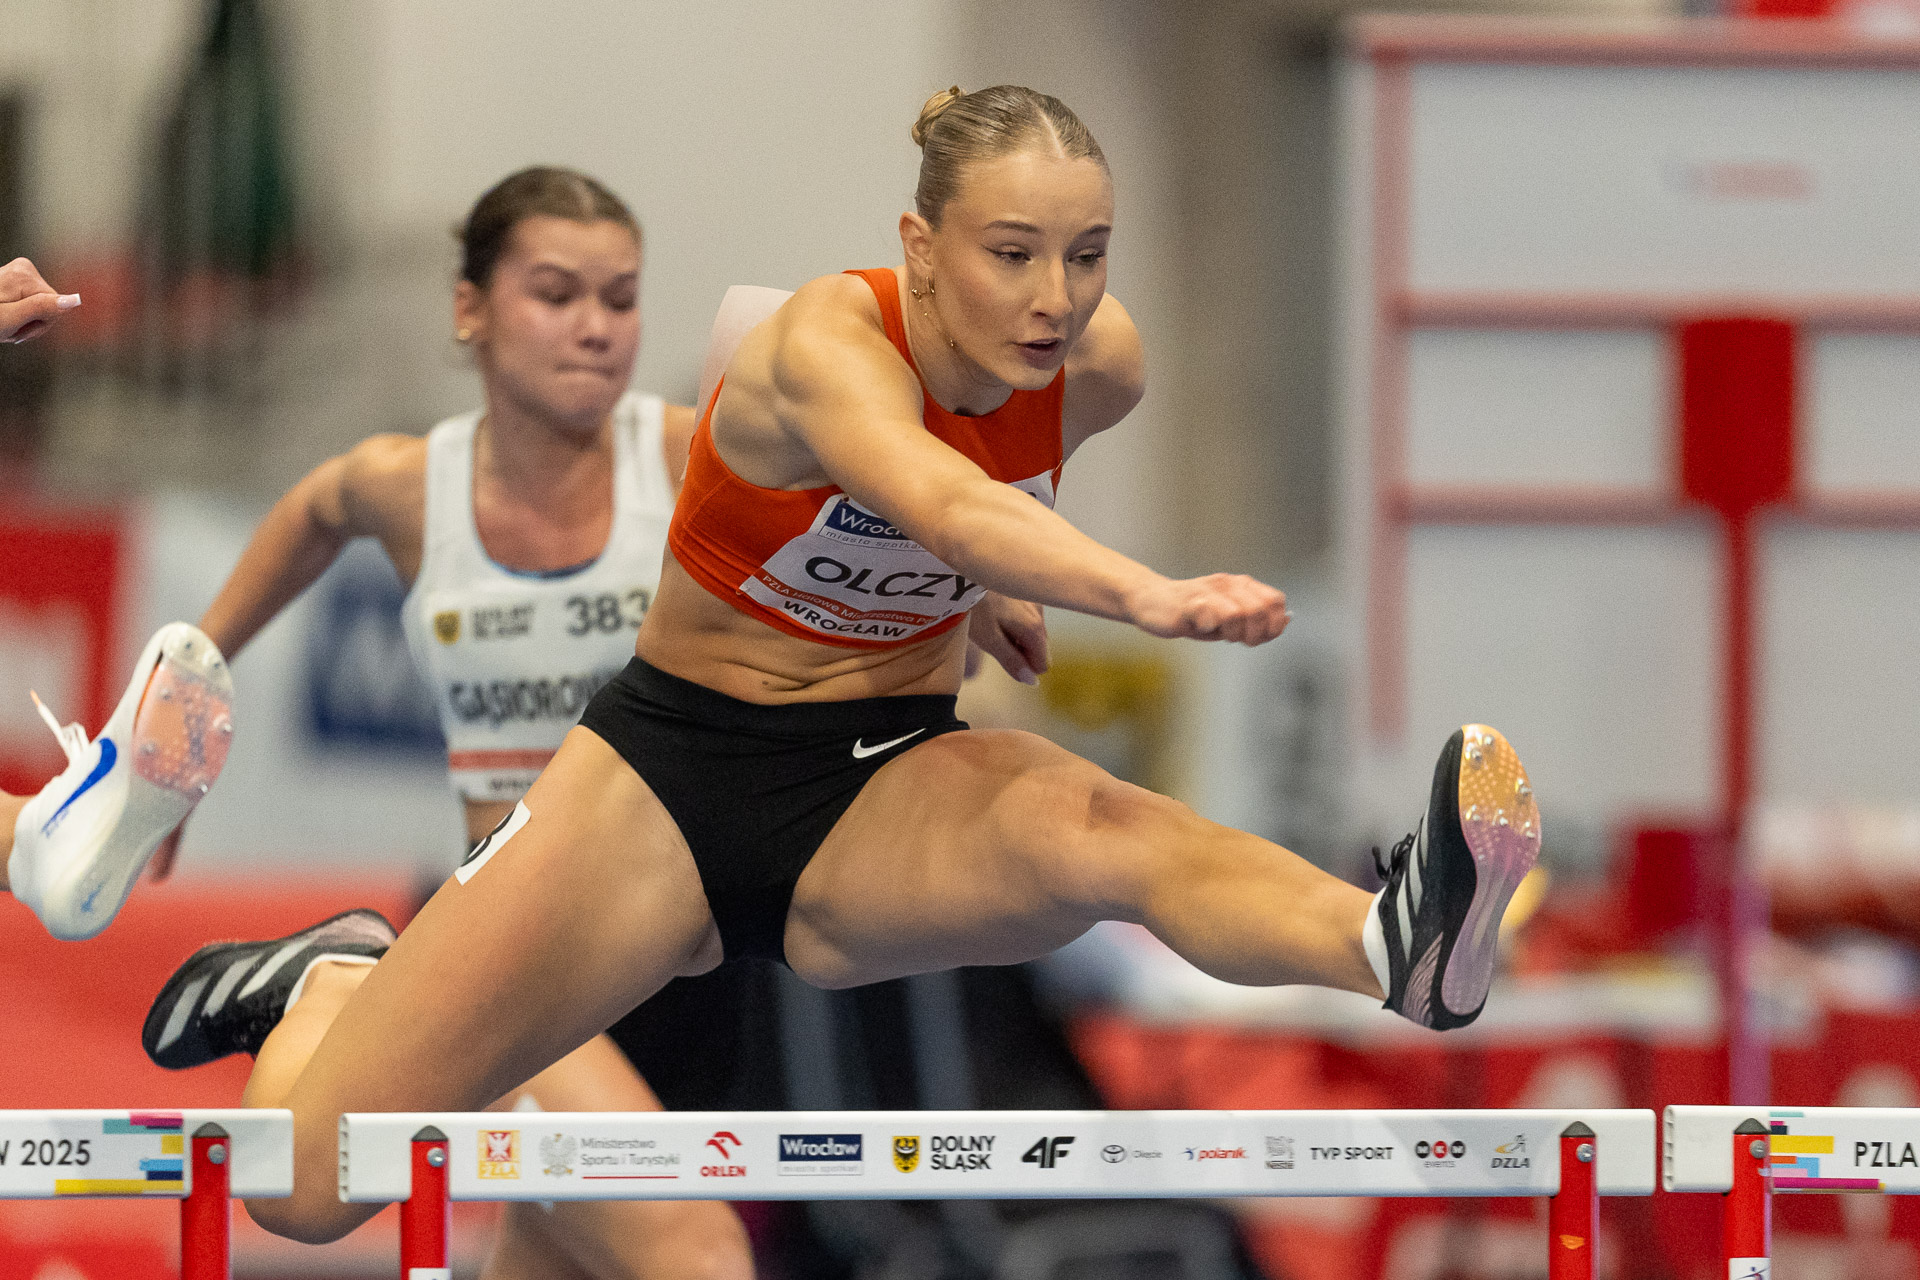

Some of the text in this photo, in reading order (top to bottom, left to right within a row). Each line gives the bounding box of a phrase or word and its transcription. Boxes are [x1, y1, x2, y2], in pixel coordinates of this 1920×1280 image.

[825, 530, 871, 545] miasto
[805, 556, 977, 602] OLCZY
[762, 575, 790, 595] PZLA
[792, 592, 840, 612] Halowe
[783, 599, 908, 637] WROCŁAW
[21, 1139, 90, 1166] 2025
[581, 1137, 656, 1149] Ministerstwo
[931, 1135, 996, 1152] DOLNY
[1021, 1136, 1076, 1168] 4F
[931, 1149, 992, 1172] ŚLĄSK
[1197, 1147, 1248, 1162] polanik
[1310, 1147, 1340, 1160] TVP
[1344, 1147, 1394, 1160] SPORT
[1491, 1157, 1531, 1168] DZLA
[1855, 1142, 1919, 1167] PZLA
[700, 1166, 746, 1177] ORLEN
